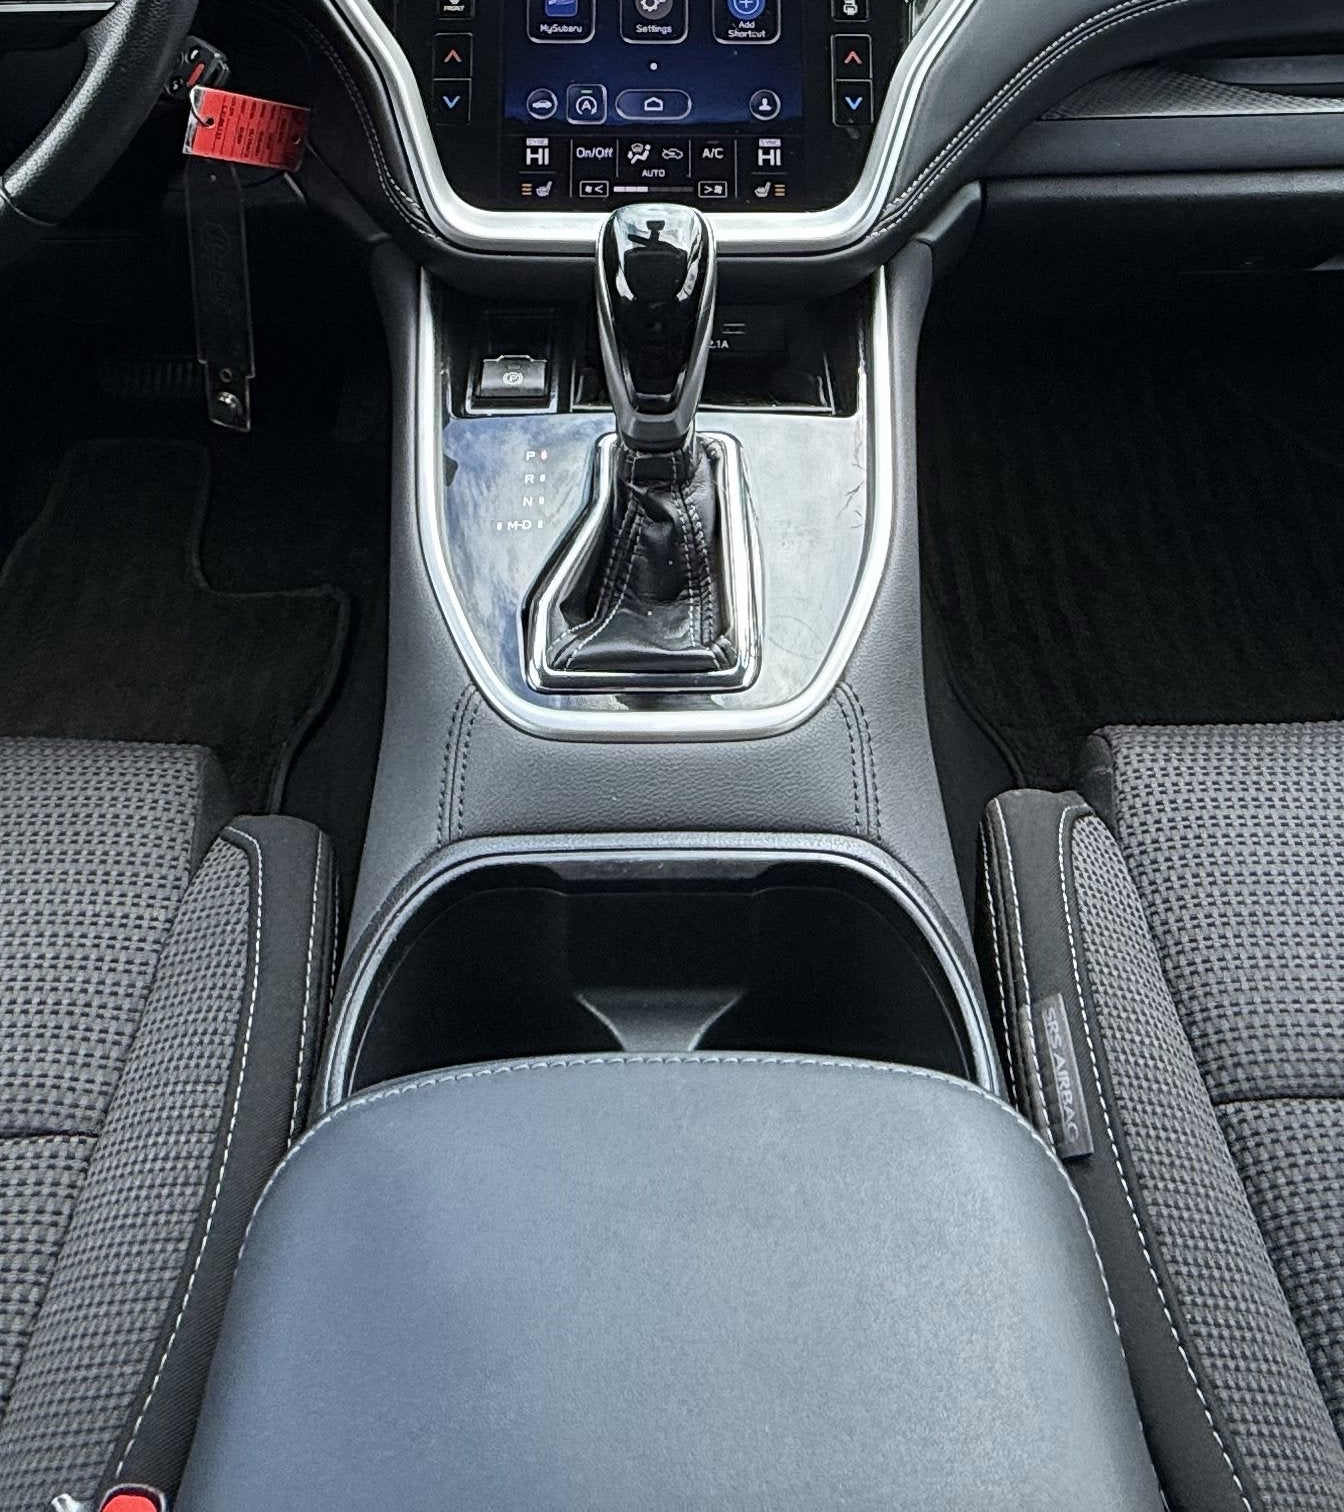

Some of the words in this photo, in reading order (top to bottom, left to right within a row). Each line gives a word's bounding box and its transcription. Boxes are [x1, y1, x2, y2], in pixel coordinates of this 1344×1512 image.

[540, 24, 583, 34] MySubaru
[636, 24, 672, 34] Settings
[728, 29, 765, 38] Shortcut
[526, 148, 549, 165] HI
[576, 147, 613, 160] On/Off
[702, 148, 724, 159] A/C
[758, 149, 781, 166] HI
[642, 169, 666, 177] AUTO
[526, 451, 536, 461] P
[524, 474, 535, 484] R
[523, 496, 533, 506] N
[1047, 1006, 1062, 1049] SRS
[1054, 1052, 1079, 1143] AIRBAG
